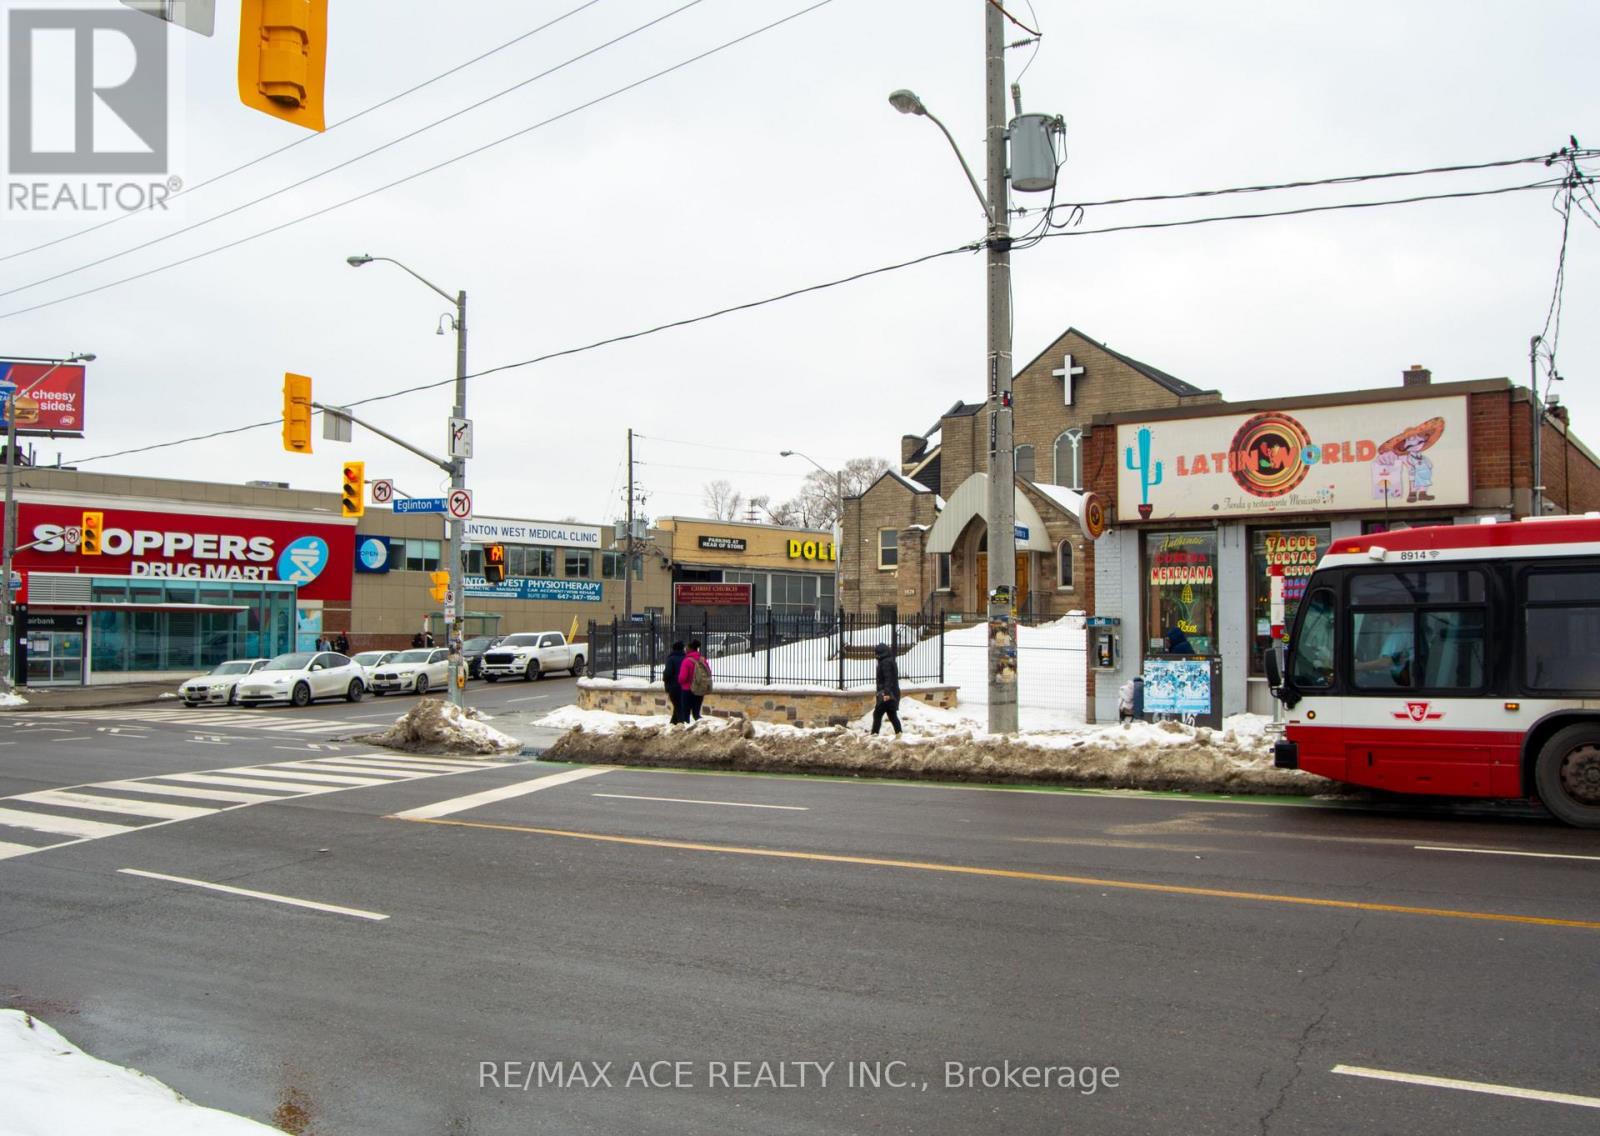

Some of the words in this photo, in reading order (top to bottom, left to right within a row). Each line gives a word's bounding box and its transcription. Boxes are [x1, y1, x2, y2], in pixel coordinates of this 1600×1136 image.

[32, 389, 76, 402] cheesy
[40, 401, 75, 411] sides.
[1176, 450, 1259, 476] LATIN
[1271, 440, 1377, 469] WORLD
[397, 500, 432, 512] Eglinton
[463, 524, 497, 536] INTON
[501, 527, 526, 537] WEST
[529, 528, 569, 540] MEDICAL
[569, 531, 598, 543] CLINIC
[32, 524, 275, 562] SOPPERS
[1265, 536, 1317, 551] TACOS
[1266, 551, 1317, 565] TORTAS
[1400, 551, 1426, 560] 8914
[131, 561, 200, 579] DRUG
[204, 564, 273, 581] MART
[1151, 566, 1213, 585] MEXICANA
[528, 580, 600, 591] PHYSIOTHERAPY
